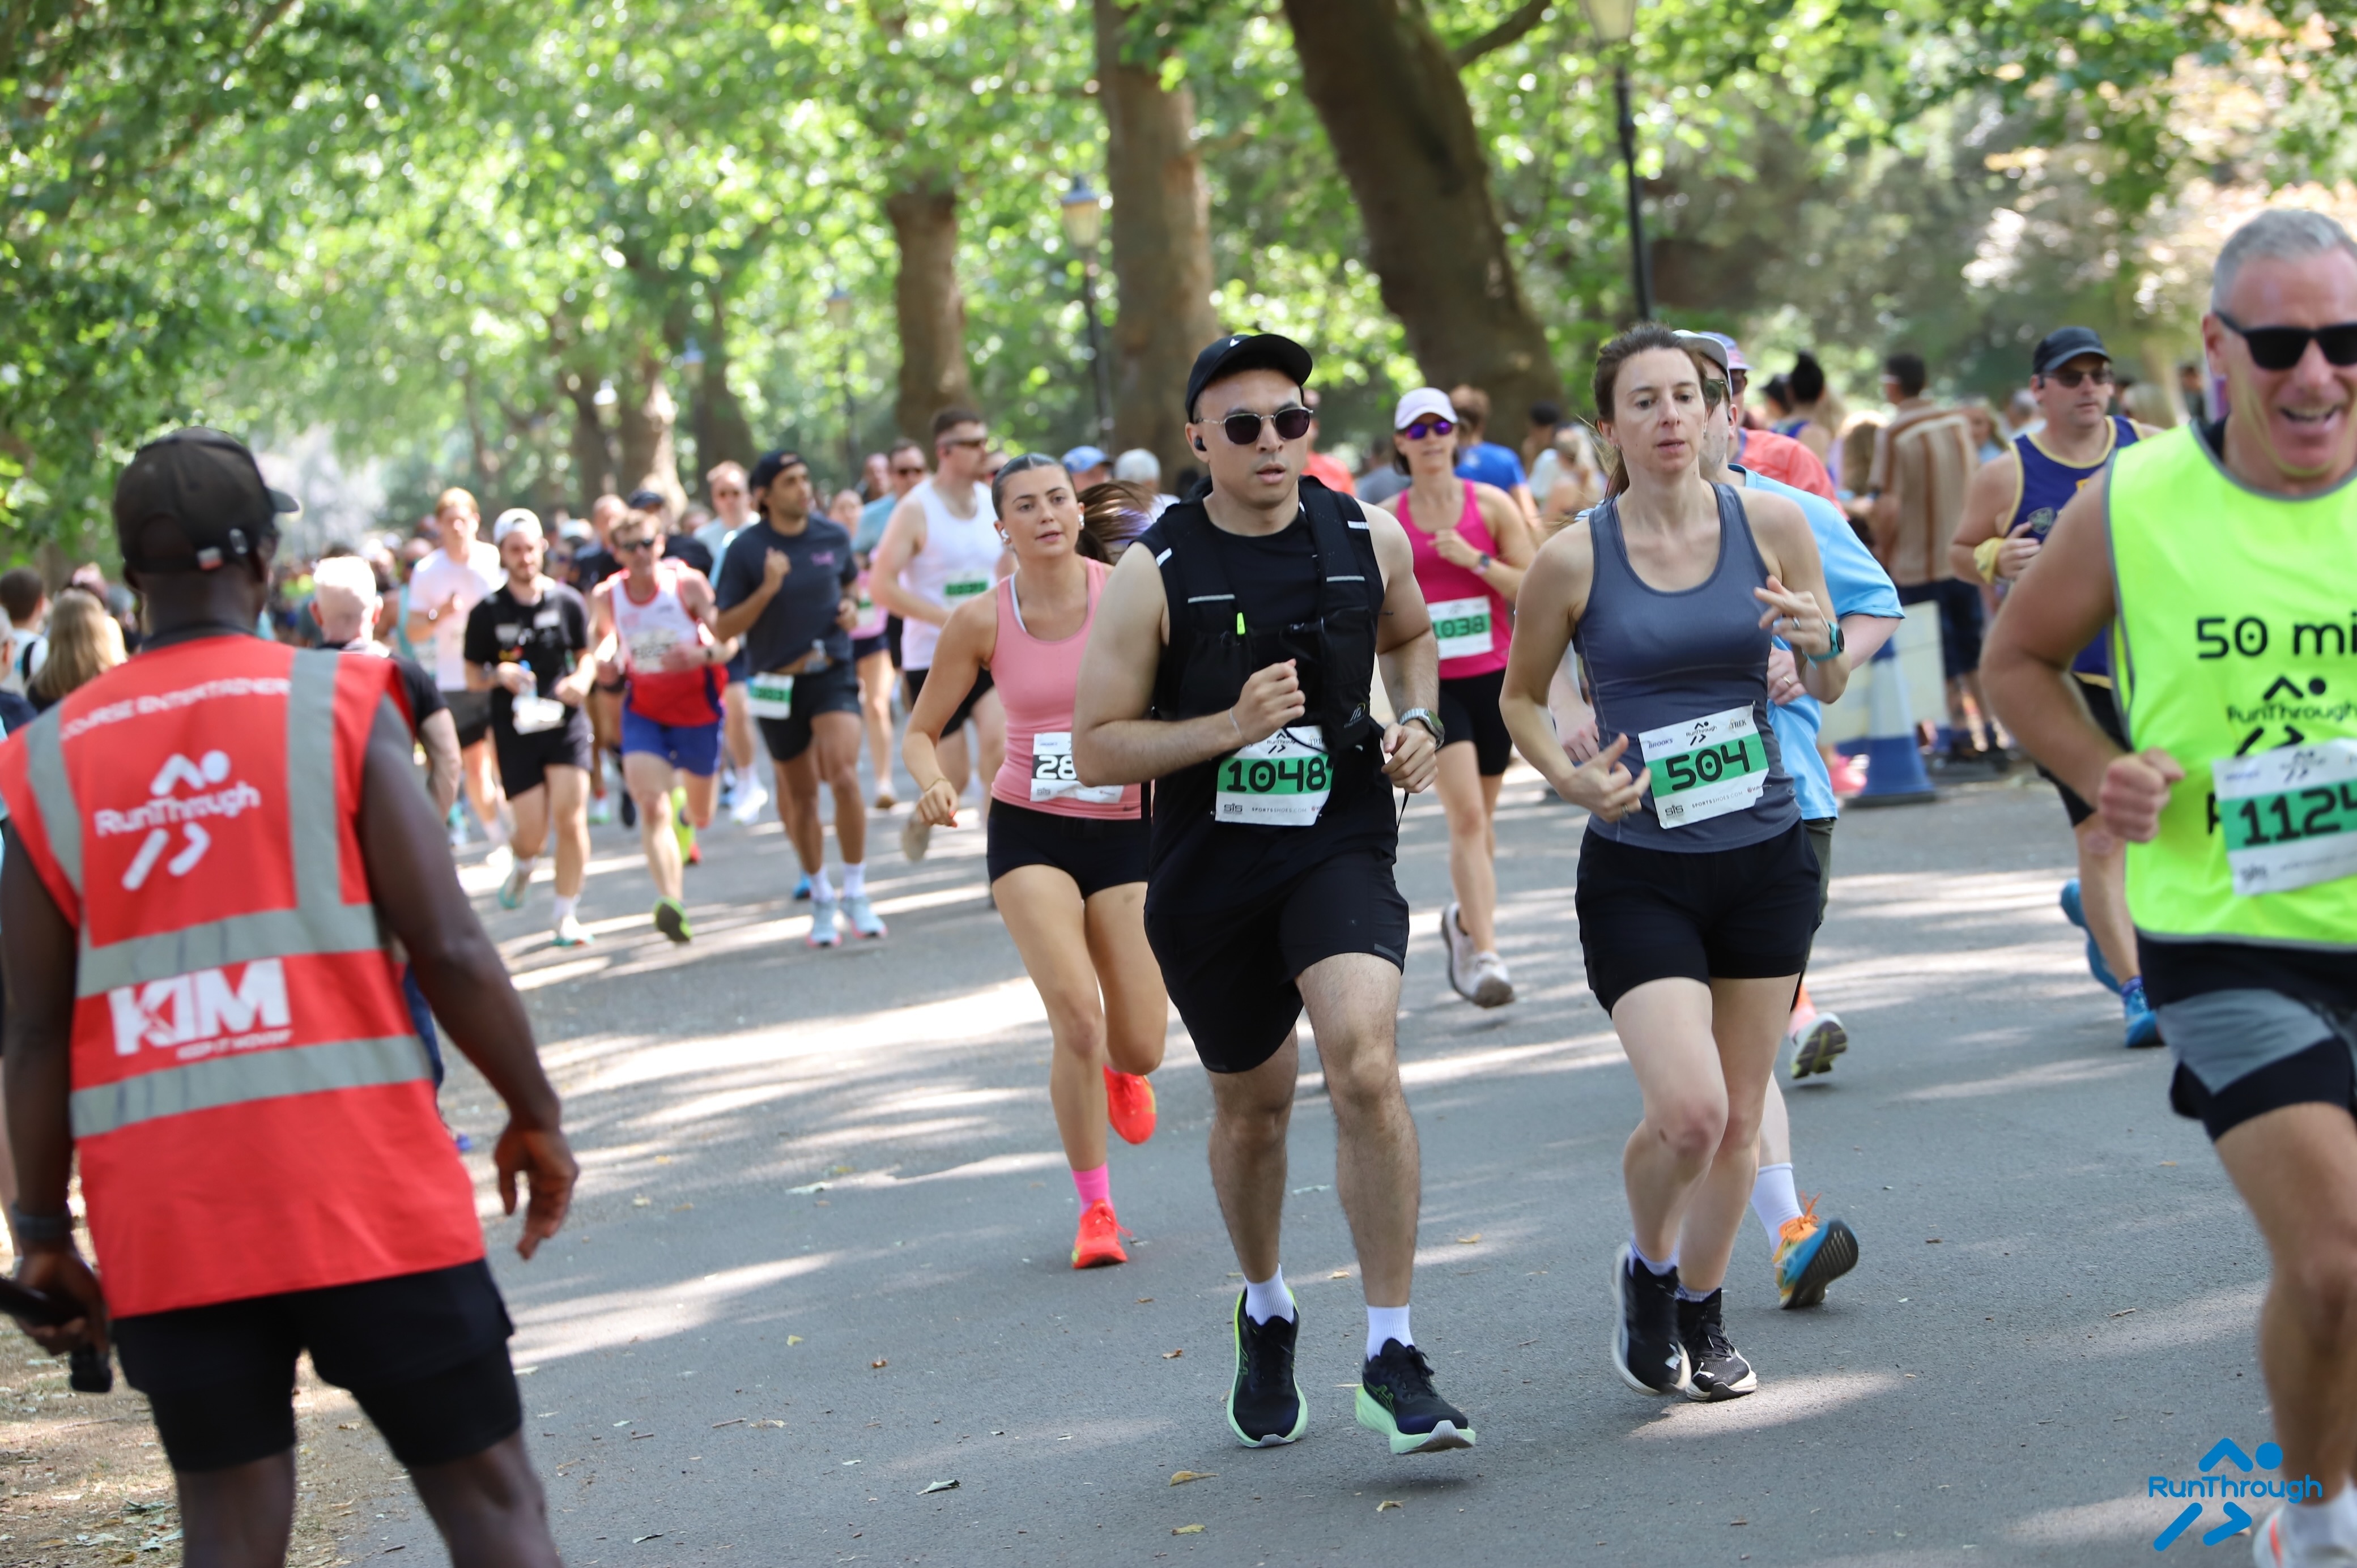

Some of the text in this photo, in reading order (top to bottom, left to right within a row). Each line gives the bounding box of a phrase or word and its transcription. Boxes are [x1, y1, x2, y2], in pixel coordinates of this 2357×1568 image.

[2197, 617, 2268, 658] 50
[1649, 738, 1673, 749] BROOKS
[1686, 725, 1717, 737] RunThrough
[1227, 757, 1326, 792] 1048
[1666, 740, 1750, 791] 504
[94, 780, 261, 838] RunThrough
[108, 957, 292, 1057] KIM
